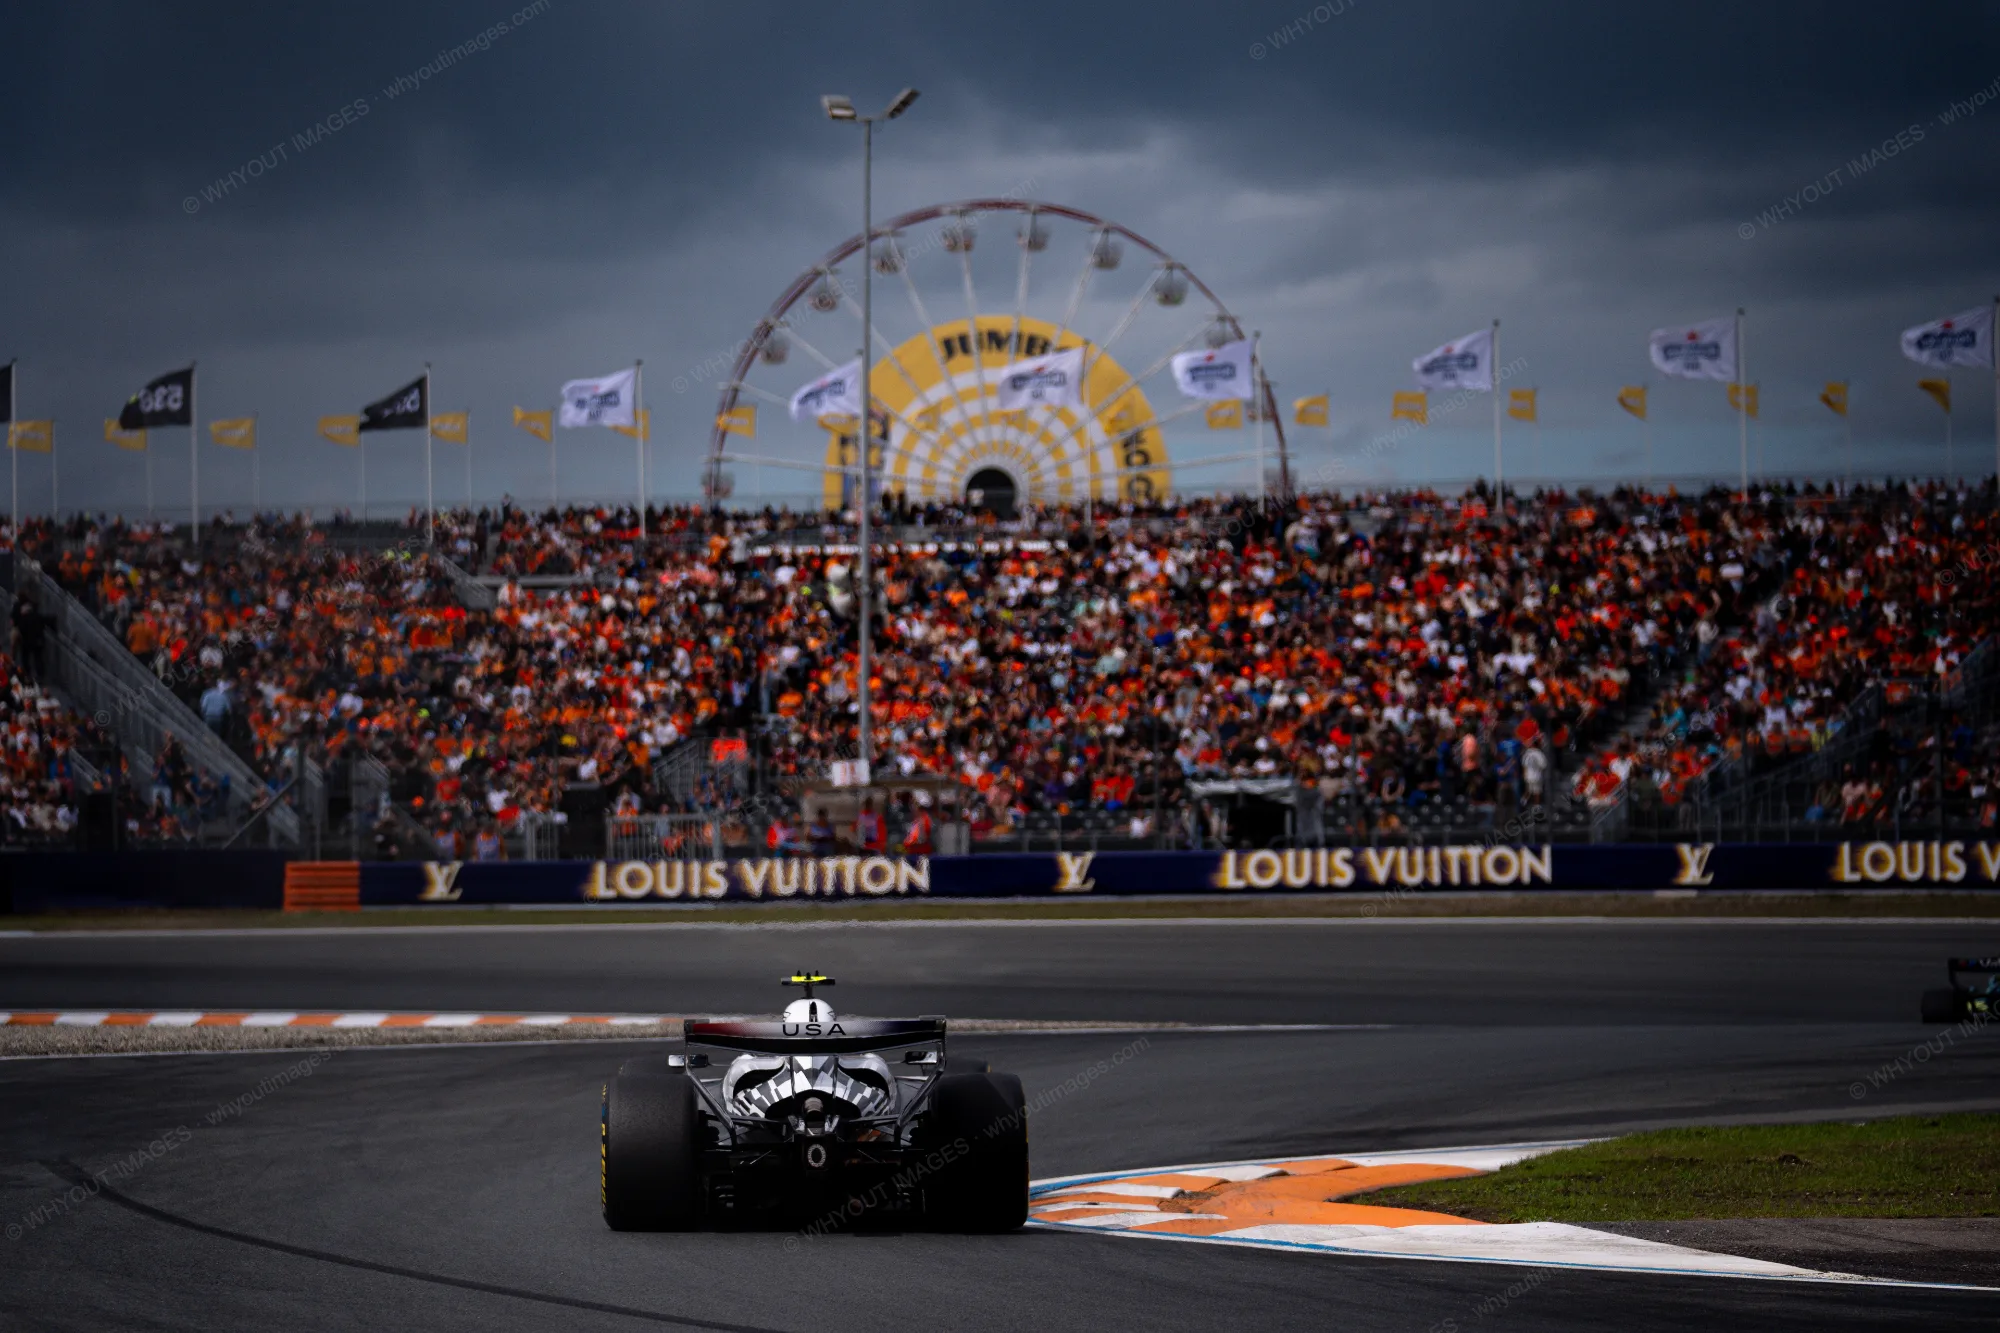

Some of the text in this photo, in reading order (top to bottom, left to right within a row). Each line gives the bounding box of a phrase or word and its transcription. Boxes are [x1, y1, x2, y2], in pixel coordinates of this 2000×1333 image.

[943, 329, 1068, 365] JUMB
[594, 859, 729, 898] LOUIS
[738, 855, 931, 897] VUITTON
[1218, 848, 1355, 889] LOUIS
[1364, 844, 1552, 886] VUITTON
[1836, 840, 1967, 882] LOUIS
[782, 1023, 847, 1037] USA
